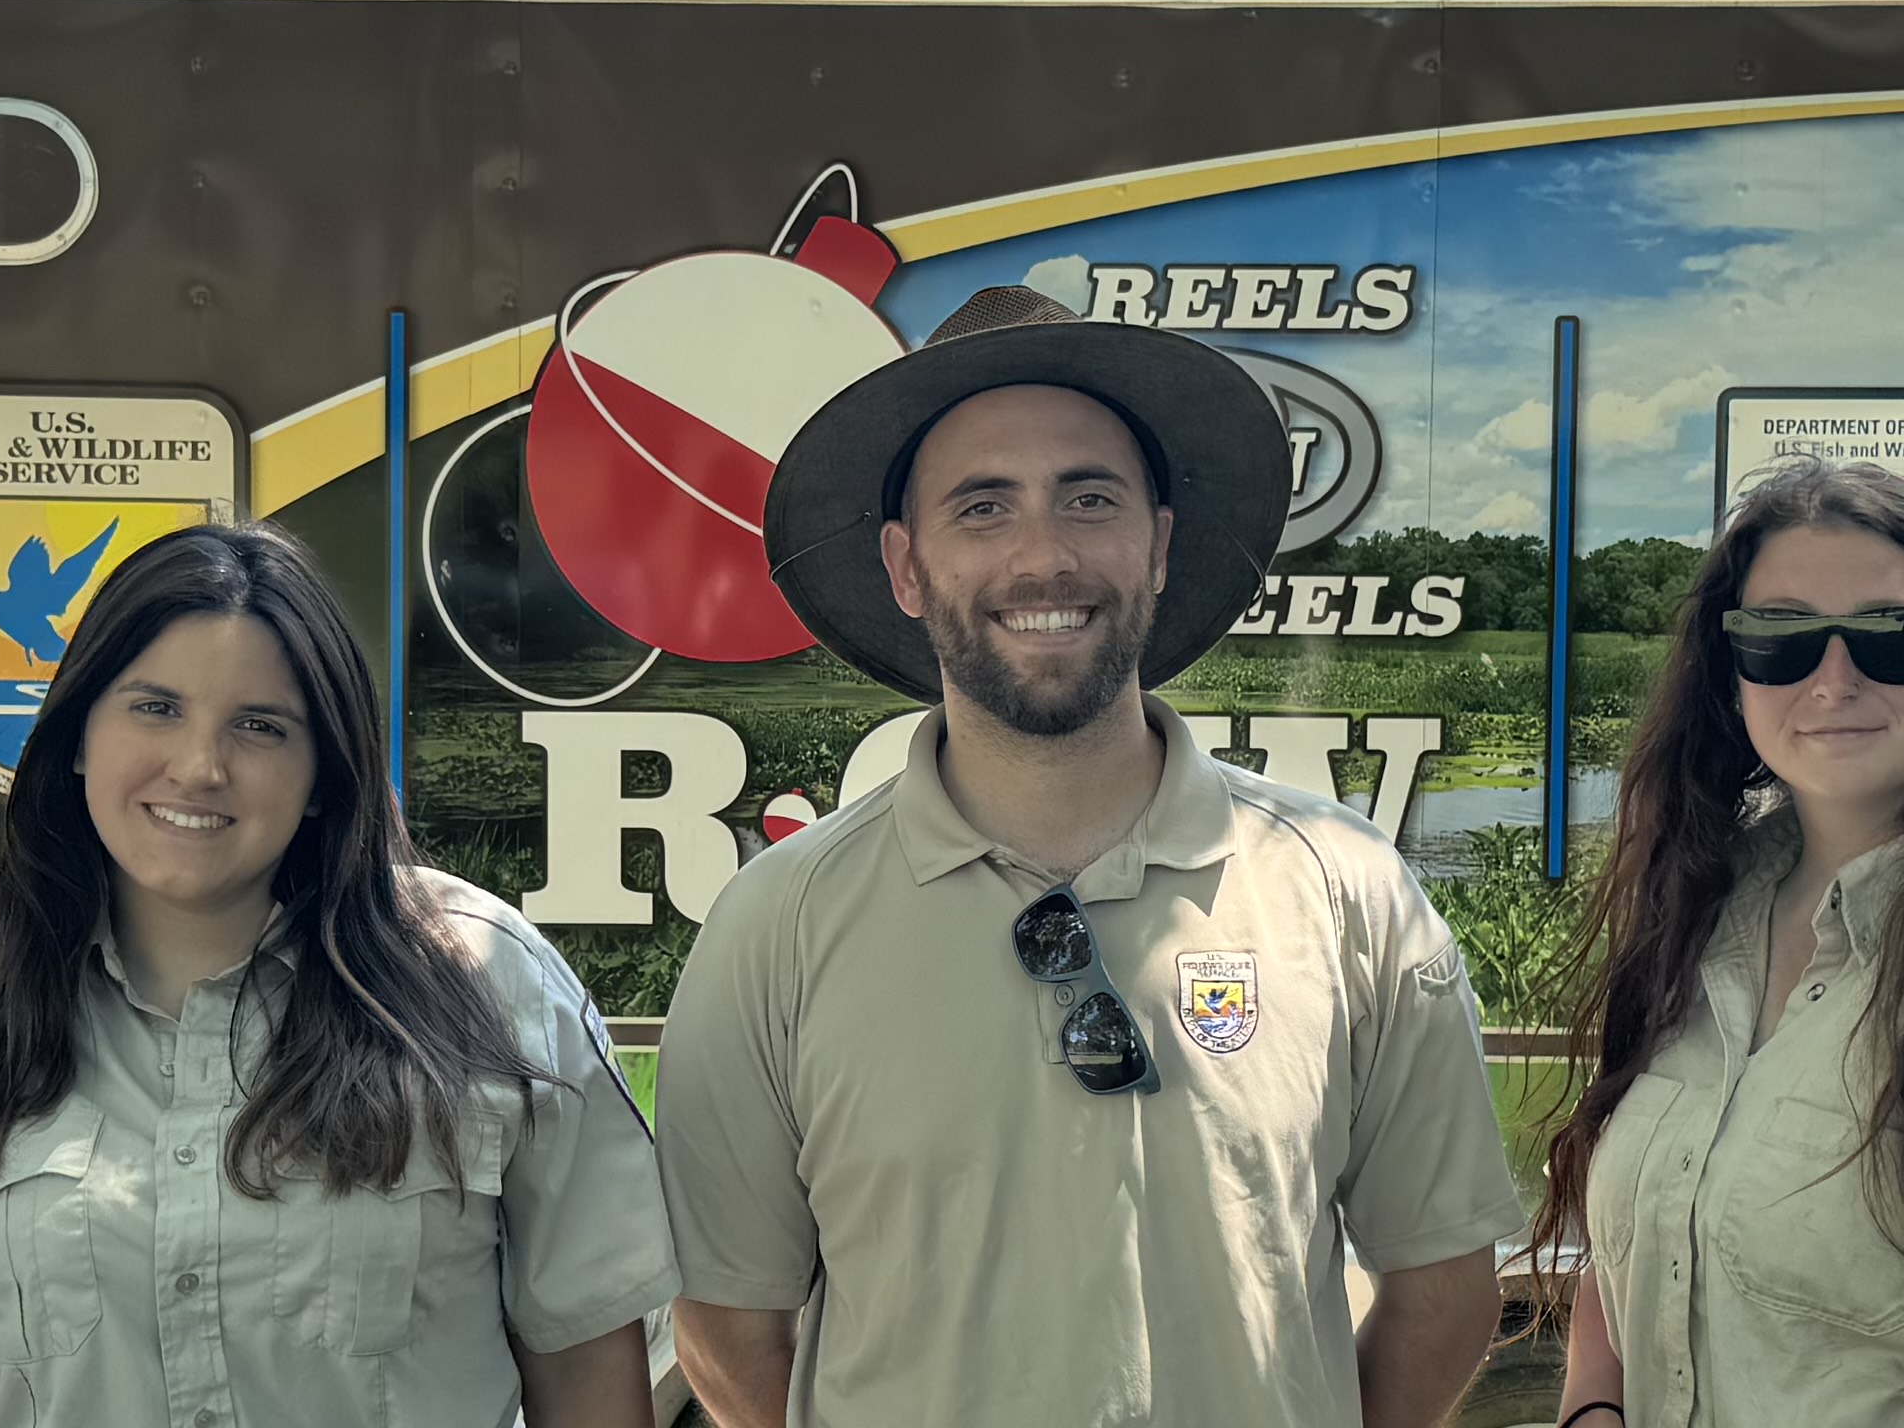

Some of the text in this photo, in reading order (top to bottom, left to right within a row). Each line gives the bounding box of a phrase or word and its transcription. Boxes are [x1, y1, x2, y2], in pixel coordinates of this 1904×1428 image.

[1085, 267, 1413, 331] REELS
[29, 411, 96, 433] U.S.
[1763, 419, 1881, 435] DEPARTMENT
[7, 437, 33, 458] &
[36, 438, 213, 461] WILDLIFE
[1811, 441, 1845, 458] Fish
[1849, 441, 1879, 458] and
[1227, 574, 1466, 637] EELS
